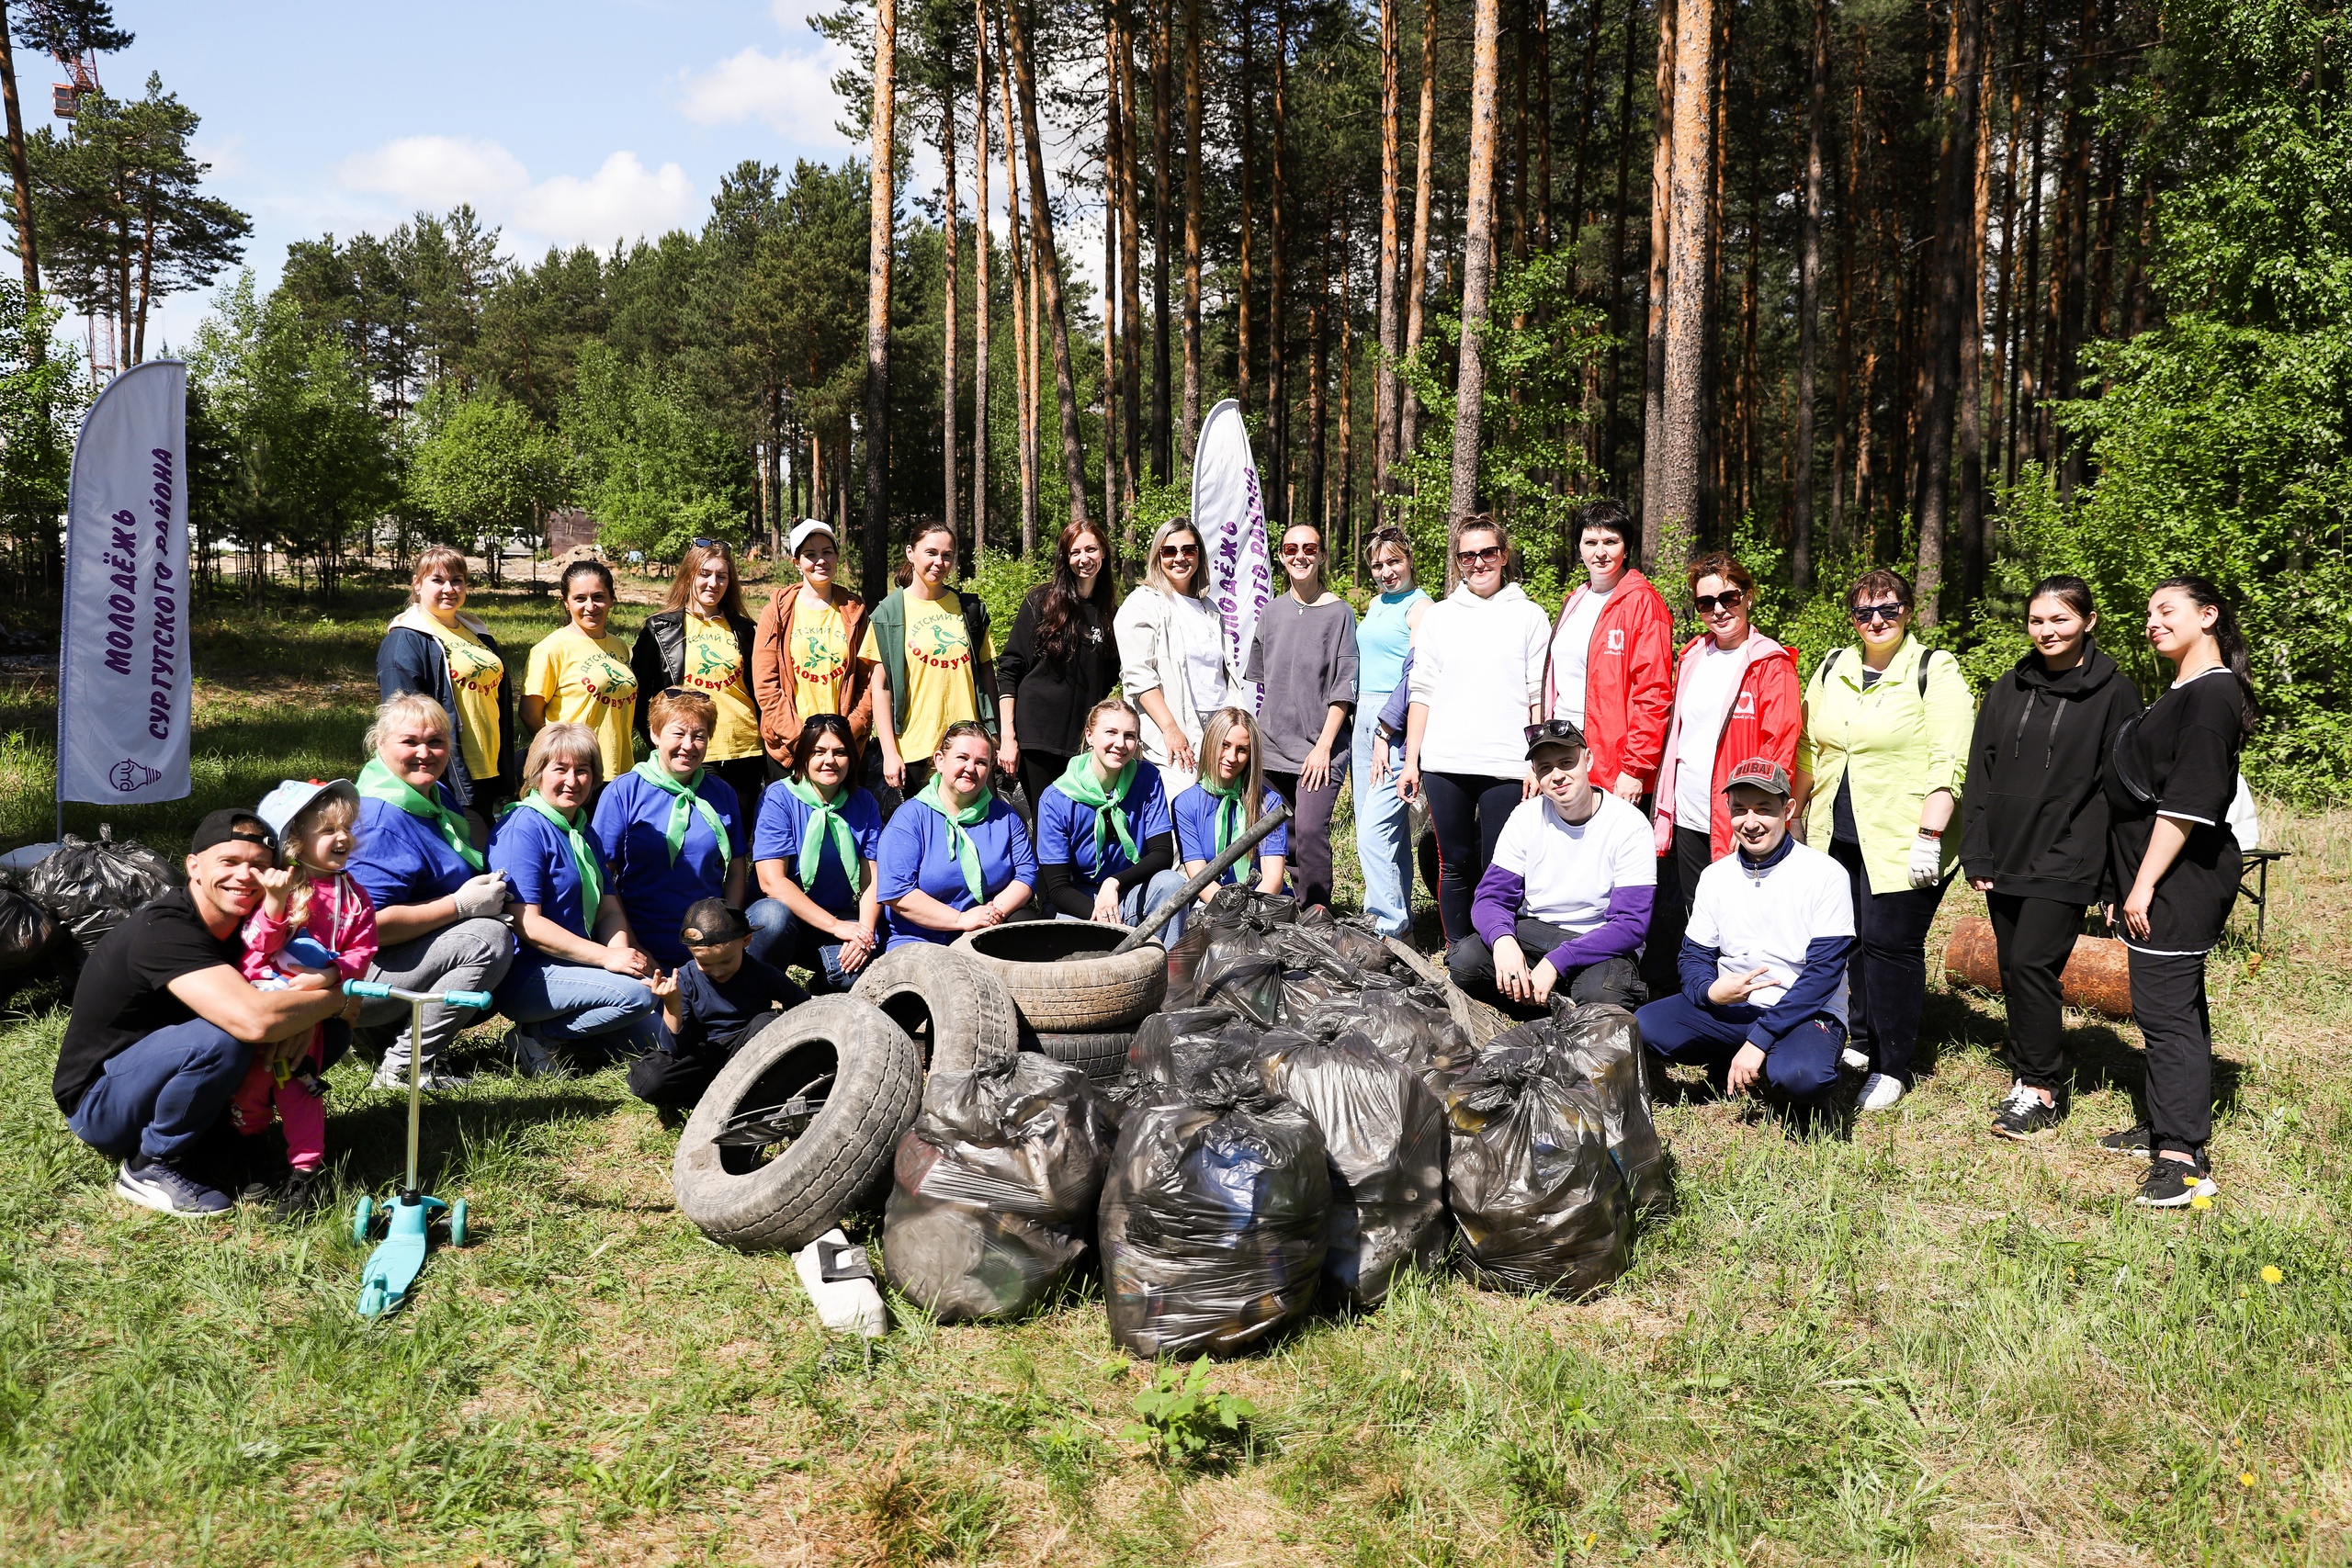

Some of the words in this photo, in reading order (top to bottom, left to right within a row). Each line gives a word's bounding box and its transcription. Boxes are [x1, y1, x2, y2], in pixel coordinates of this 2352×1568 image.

[149, 448, 173, 557] РАЙОНА
[1243, 467, 1267, 559] РАЙОНА
[103, 509, 138, 675] МОЛОДЁЖЬ
[149, 561, 175, 740] СУРГУТСКОГО
[581, 650, 616, 673] ДЕТСКИЙ
[1736, 761, 1771, 776] DUBAI
